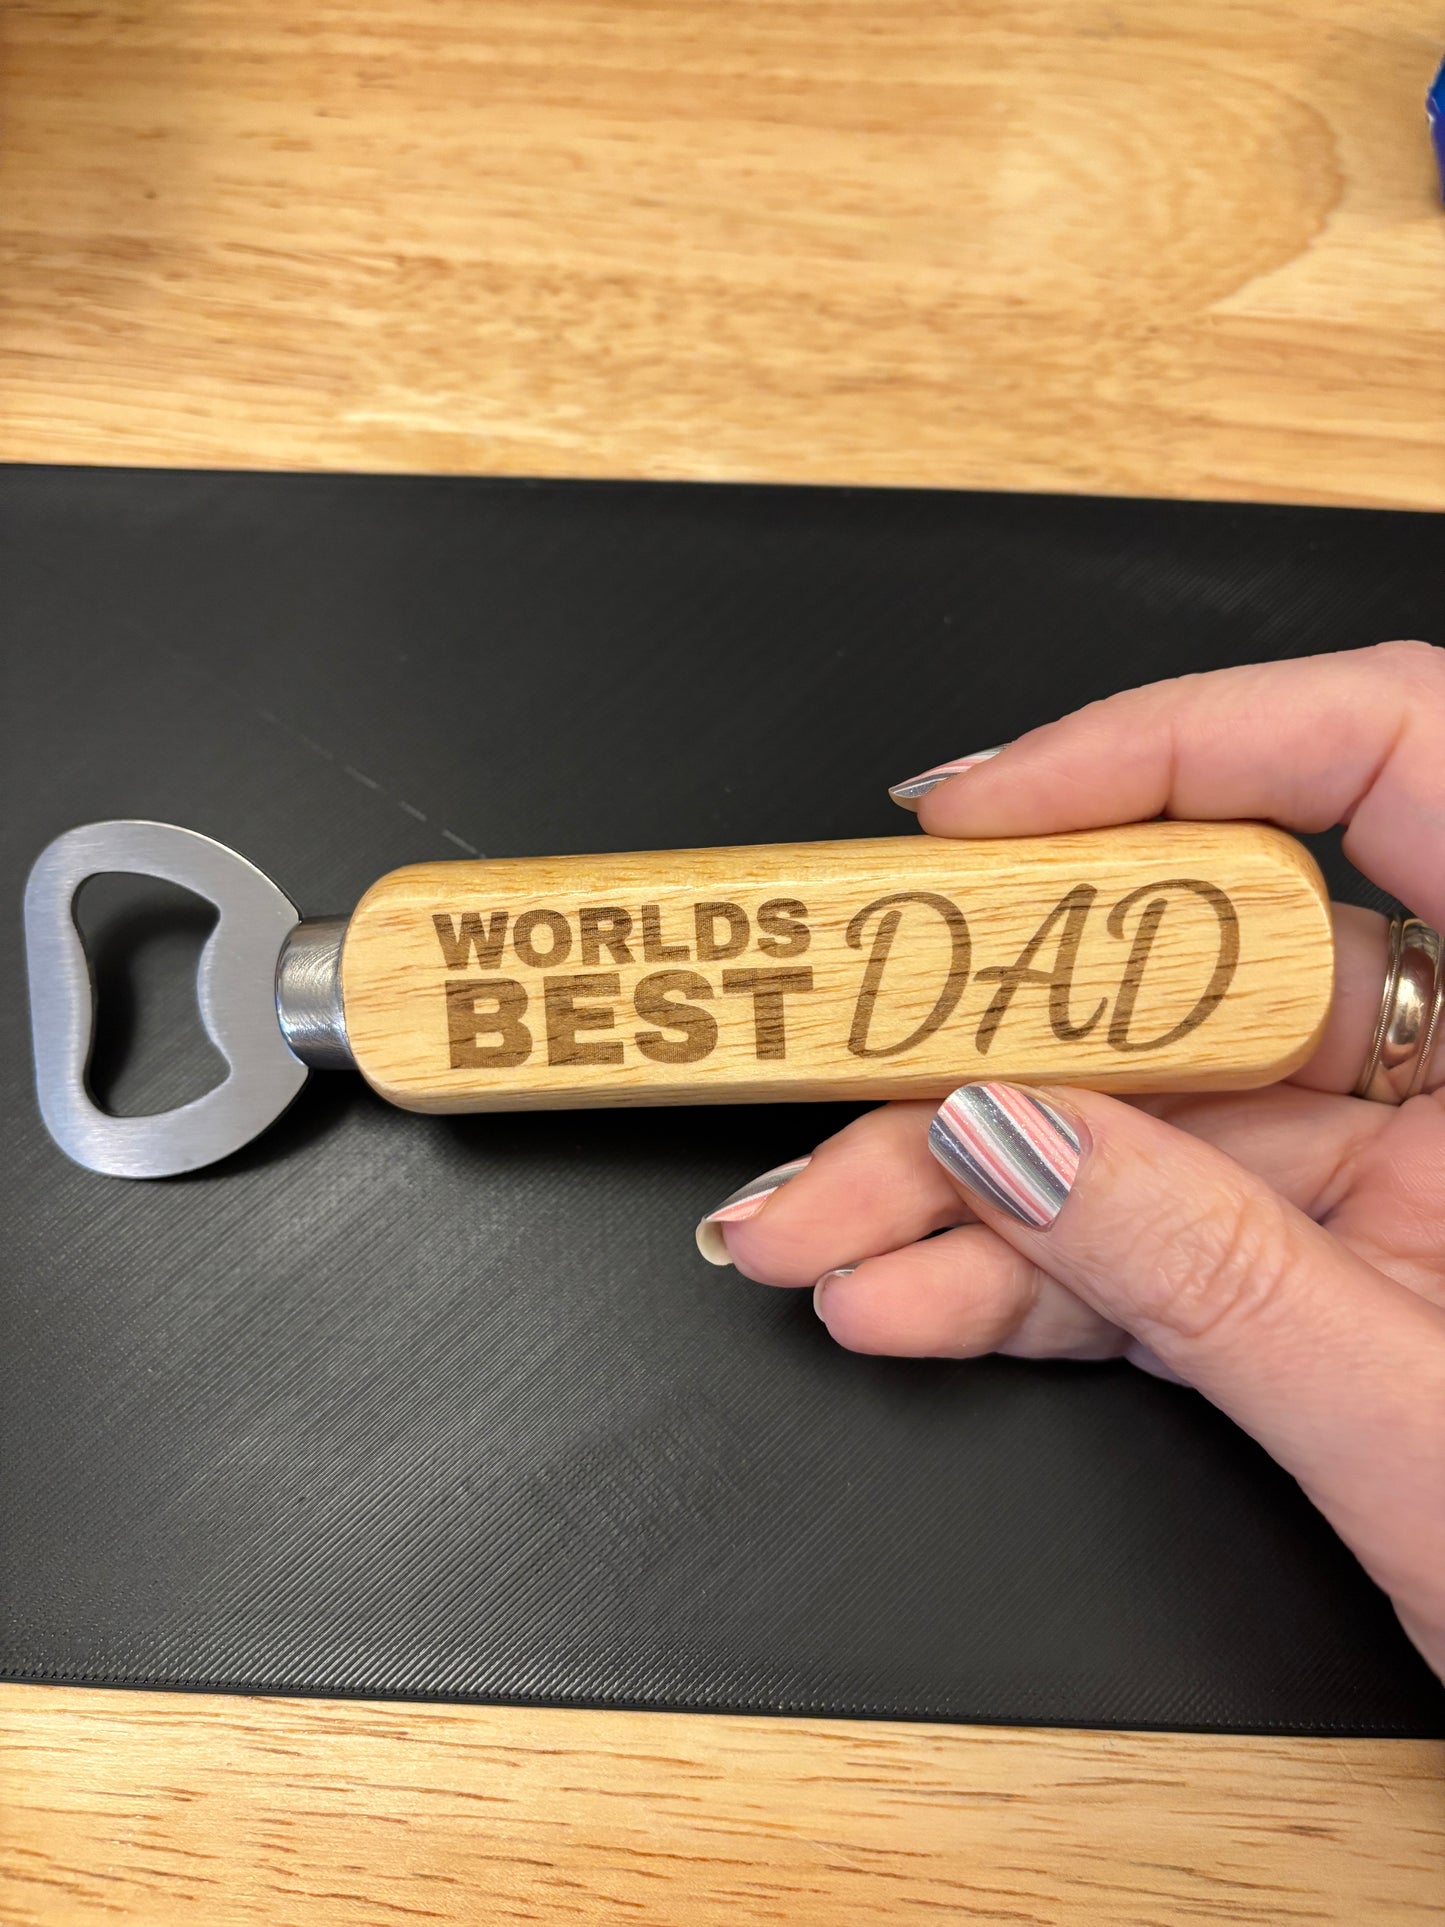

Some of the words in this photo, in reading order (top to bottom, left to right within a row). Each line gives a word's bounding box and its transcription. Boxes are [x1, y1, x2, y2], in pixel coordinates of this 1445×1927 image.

[432, 898, 811, 970] WORLDS
[845, 878, 1240, 1059] DAD
[445, 966, 813, 1069] BEST
